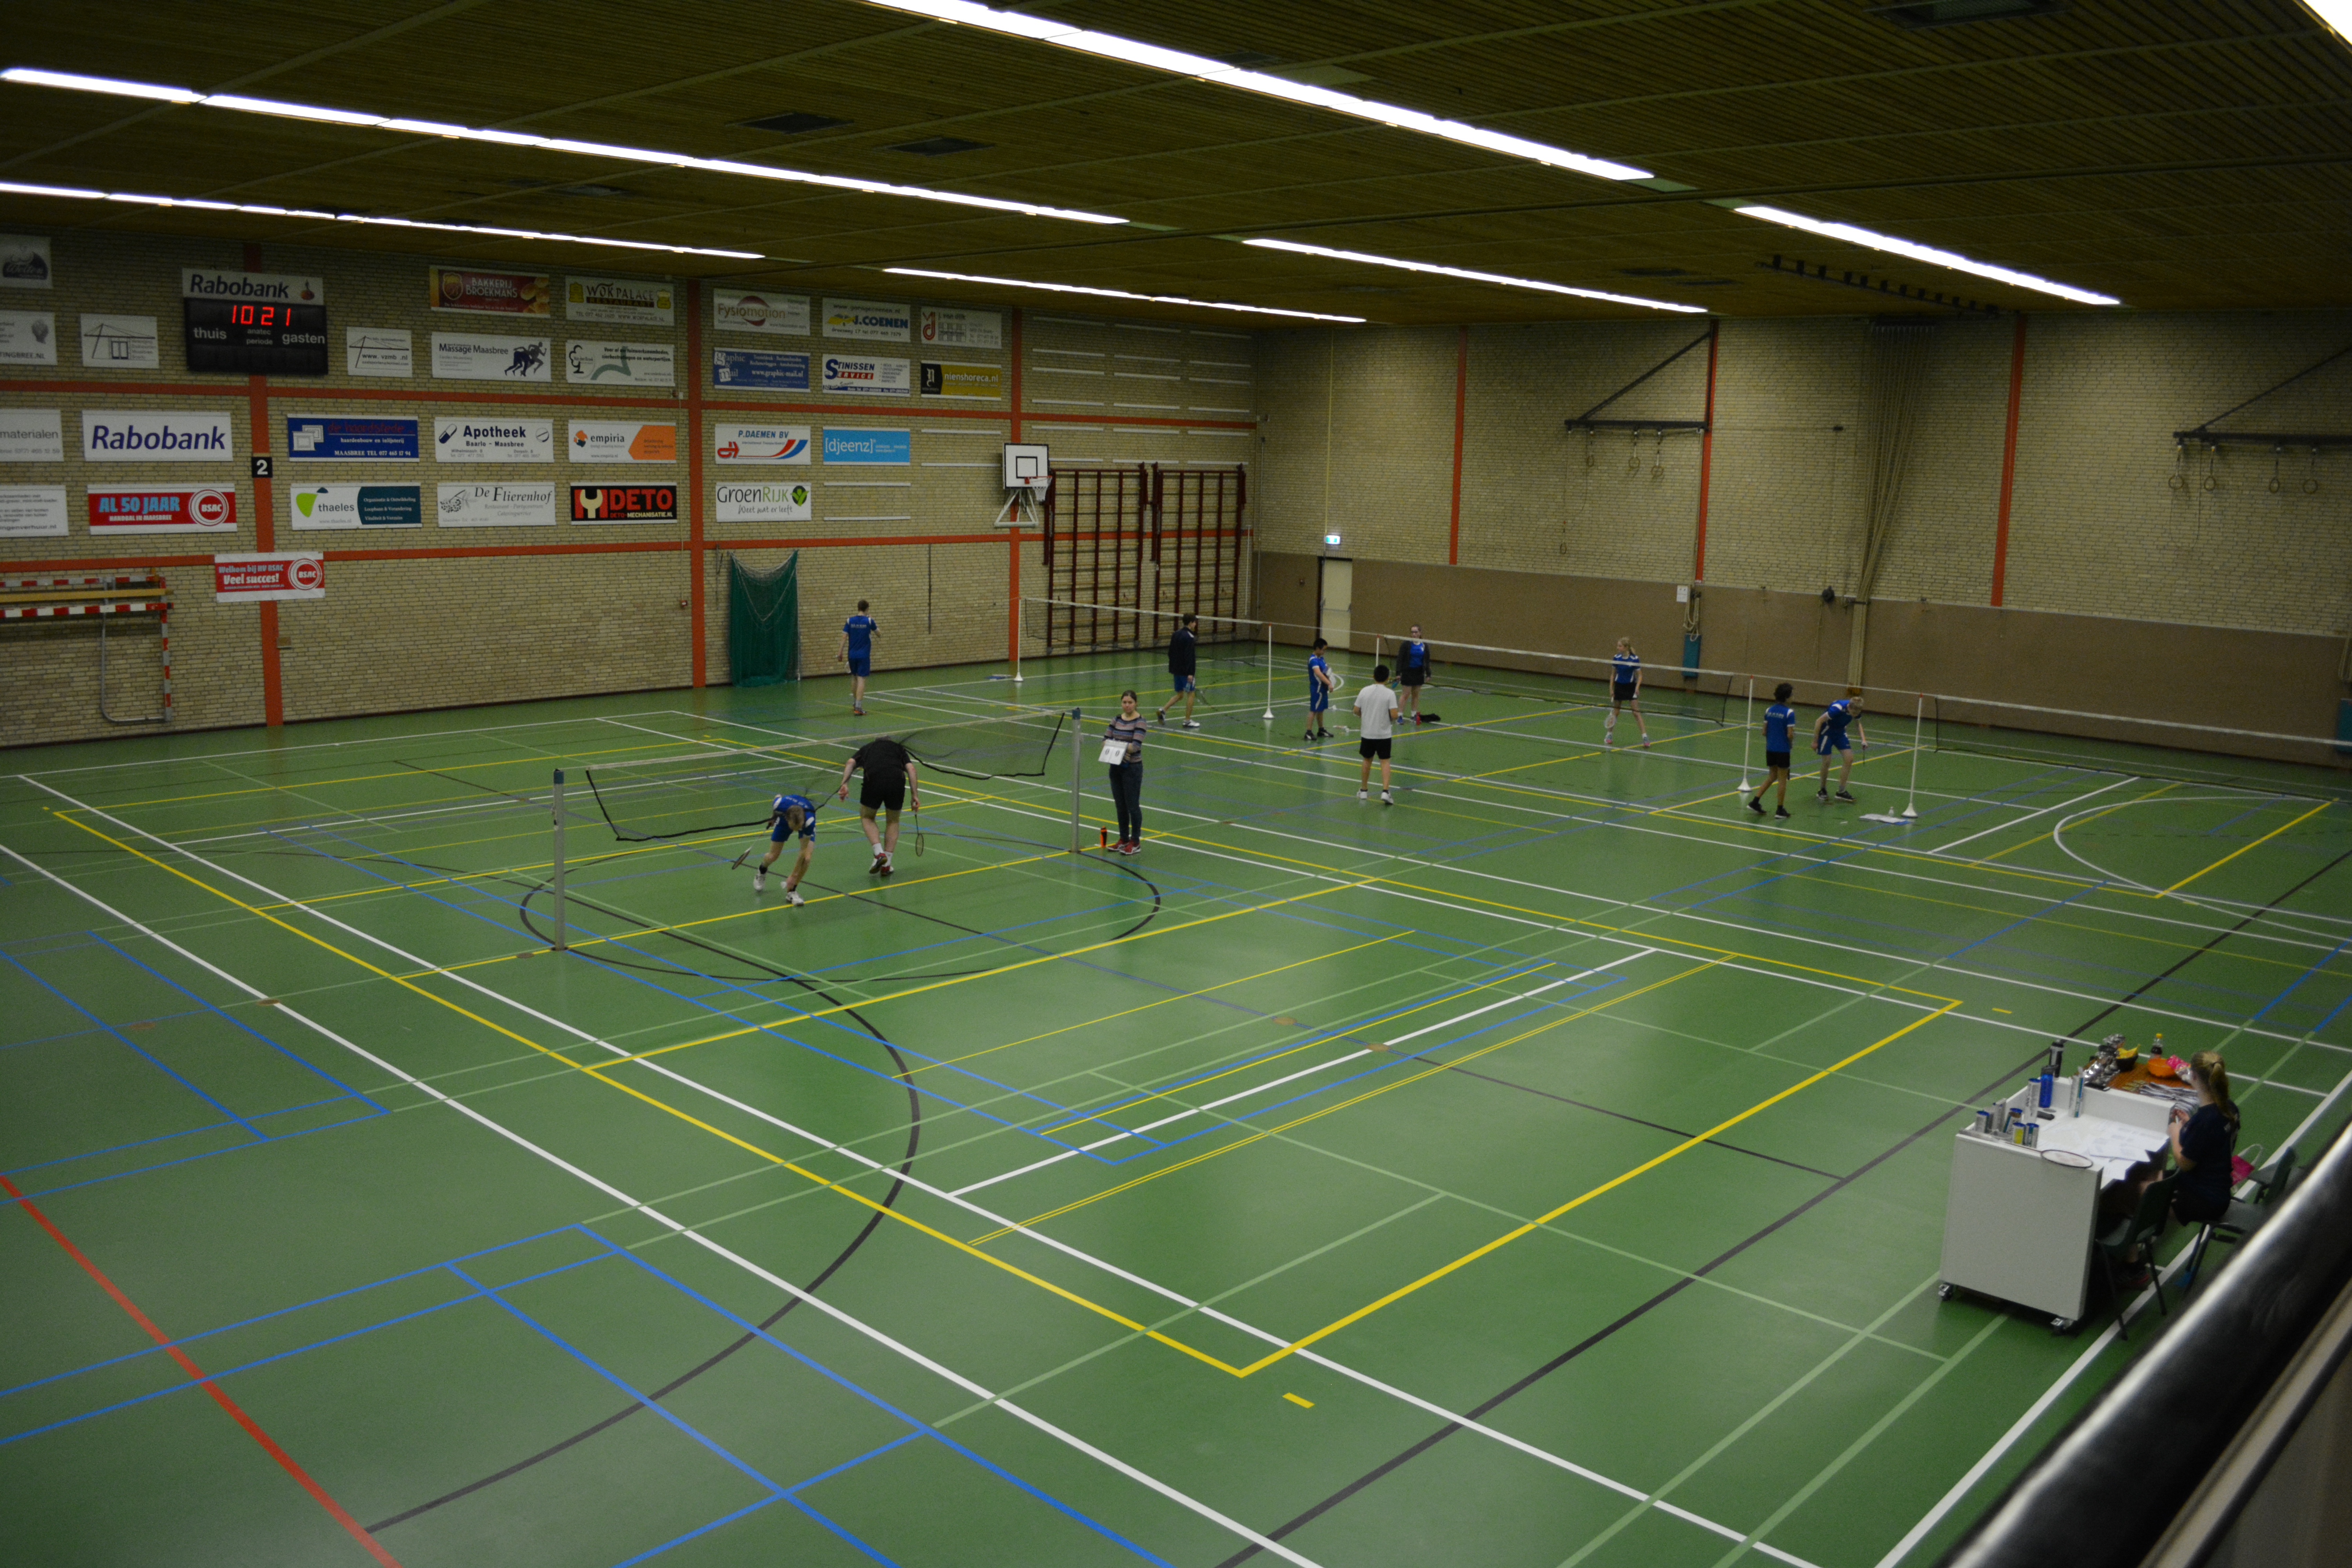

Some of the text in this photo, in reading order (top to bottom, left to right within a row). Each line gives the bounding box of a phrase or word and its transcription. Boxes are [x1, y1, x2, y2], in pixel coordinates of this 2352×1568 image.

[191, 274, 290, 299] Rabobank
[472, 277, 512, 288] BAKKERIJ
[466, 285, 518, 298] BROEKMANS
[616, 288, 653, 300] PALACE
[590, 298, 651, 307] RESTAURANT
[718, 303, 786, 318] Fysiomotion
[854, 315, 908, 328] J.COENEN
[194, 327, 227, 340] thuis
[282, 333, 326, 345] gasten
[439, 343, 472, 354] Massage
[473, 345, 508, 354] Maasbree
[945, 372, 998, 382] nienshoreca.nl
[92, 425, 225, 450] Rabobank
[463, 425, 526, 439] Apotheek
[738, 430, 776, 438] P.DAEMEN
[590, 433, 624, 444] empiria
[256, 459, 268, 475] 2
[474, 486, 553, 505] De Flierenhof
[610, 489, 673, 510] DETO
[99, 496, 180, 514] AL 50 JAAR
[201, 504, 222, 512] BSAC
[318, 503, 355, 512] thaeles
[738, 505, 755, 514] Weet
[757, 506, 769, 514] wat
[779, 504, 793, 515] leeft
[219, 565, 246, 573] Welkom
[247, 564, 257, 574] bij
[223, 573, 279, 584] Veel succes!
